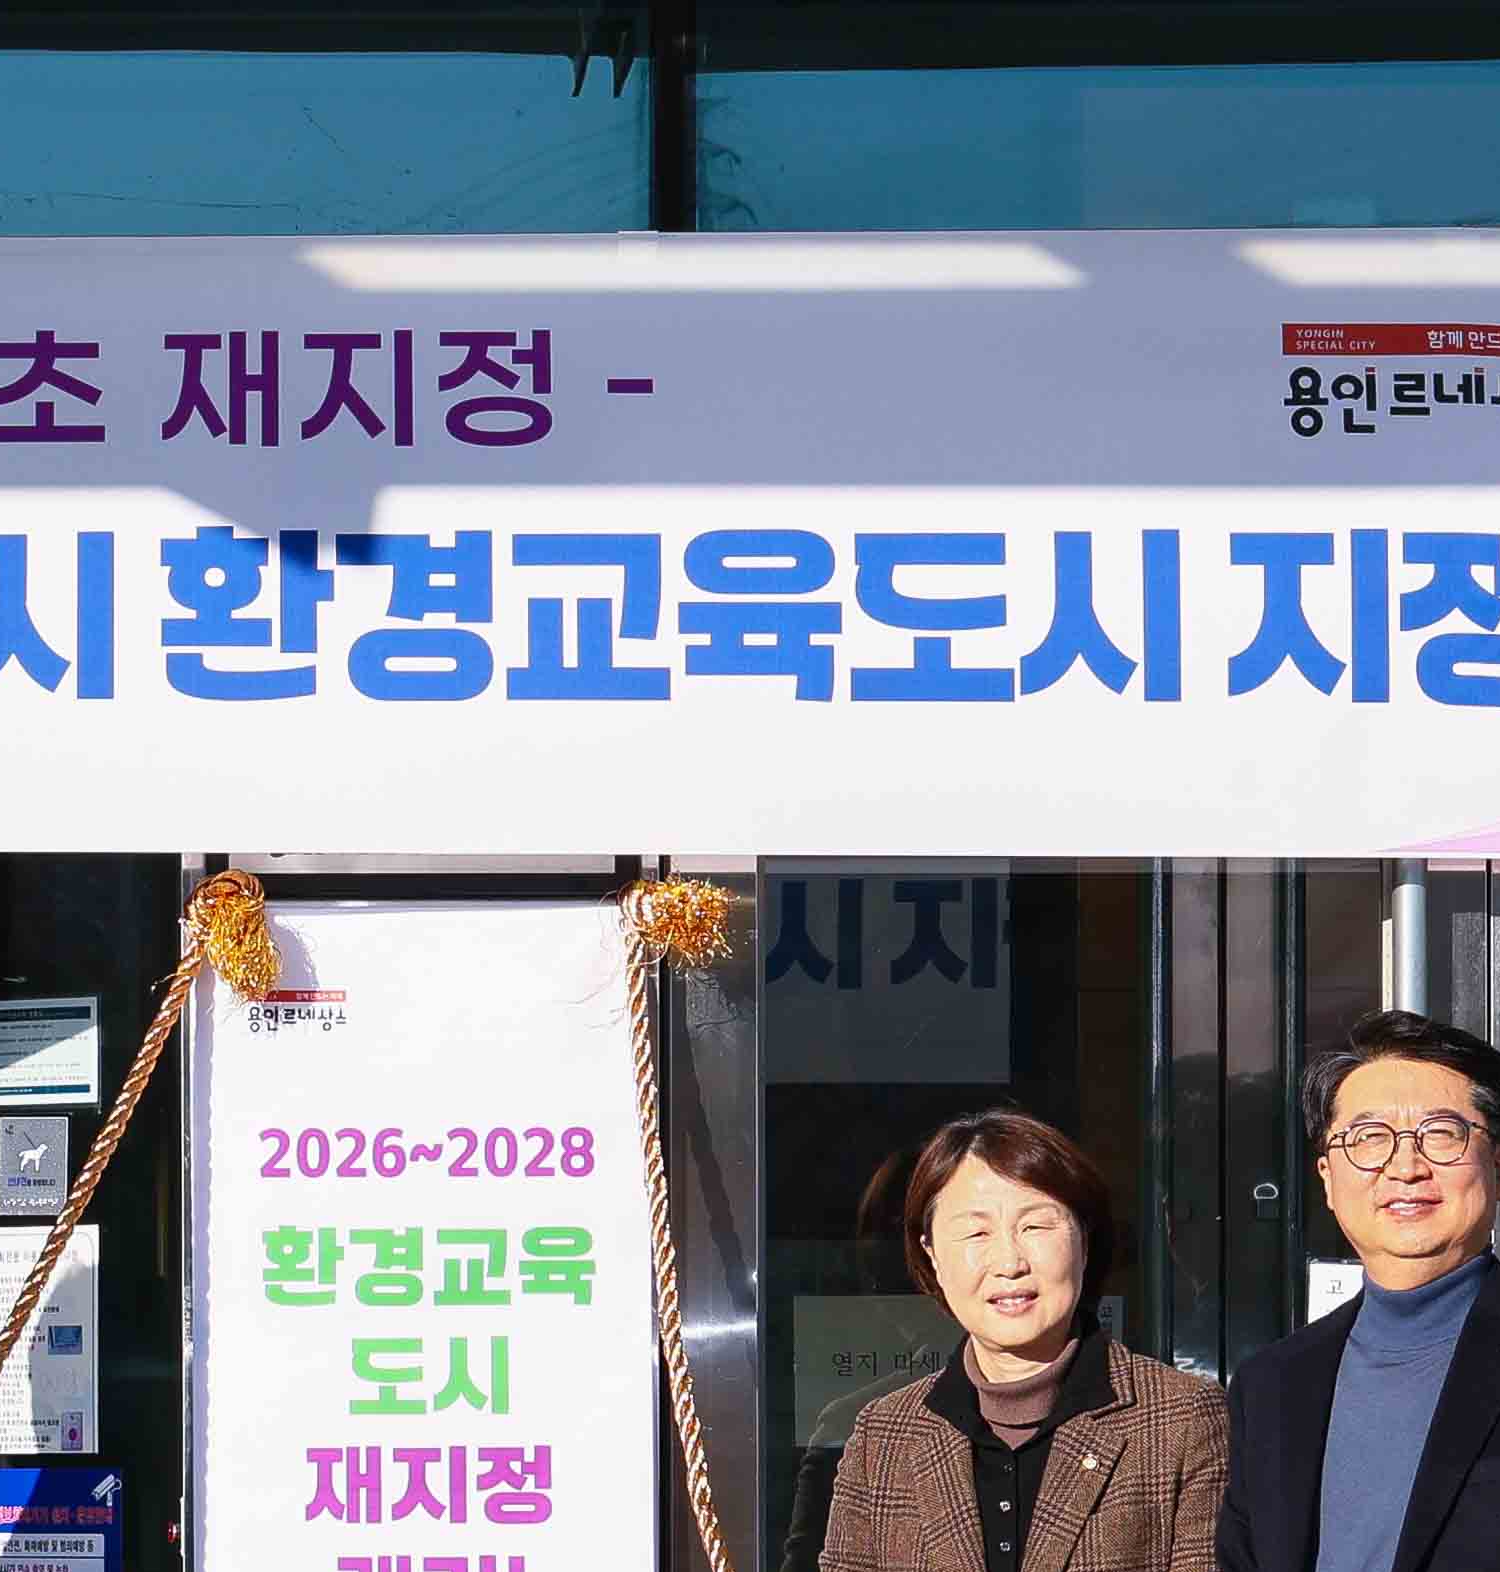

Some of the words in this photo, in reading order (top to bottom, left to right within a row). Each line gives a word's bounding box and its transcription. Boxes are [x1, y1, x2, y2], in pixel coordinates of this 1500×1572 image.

[1296, 329, 1344, 338] YONGIN
[1296, 340, 1346, 350] SPECIAL
[1350, 340, 1376, 350] CITY
[1427, 330, 1463, 350] 함께
[161, 328, 554, 448] 재지정
[160, 526, 1182, 703] 환경교육도시
[259, 1127, 595, 1178] 2026~2028
[261, 1225, 596, 1306] 환경교육
[351, 1336, 510, 1416] 도시
[831, 1351, 878, 1377] 열지
[894, 1351, 942, 1377] 마세
[305, 1444, 554, 1525] 재지정
